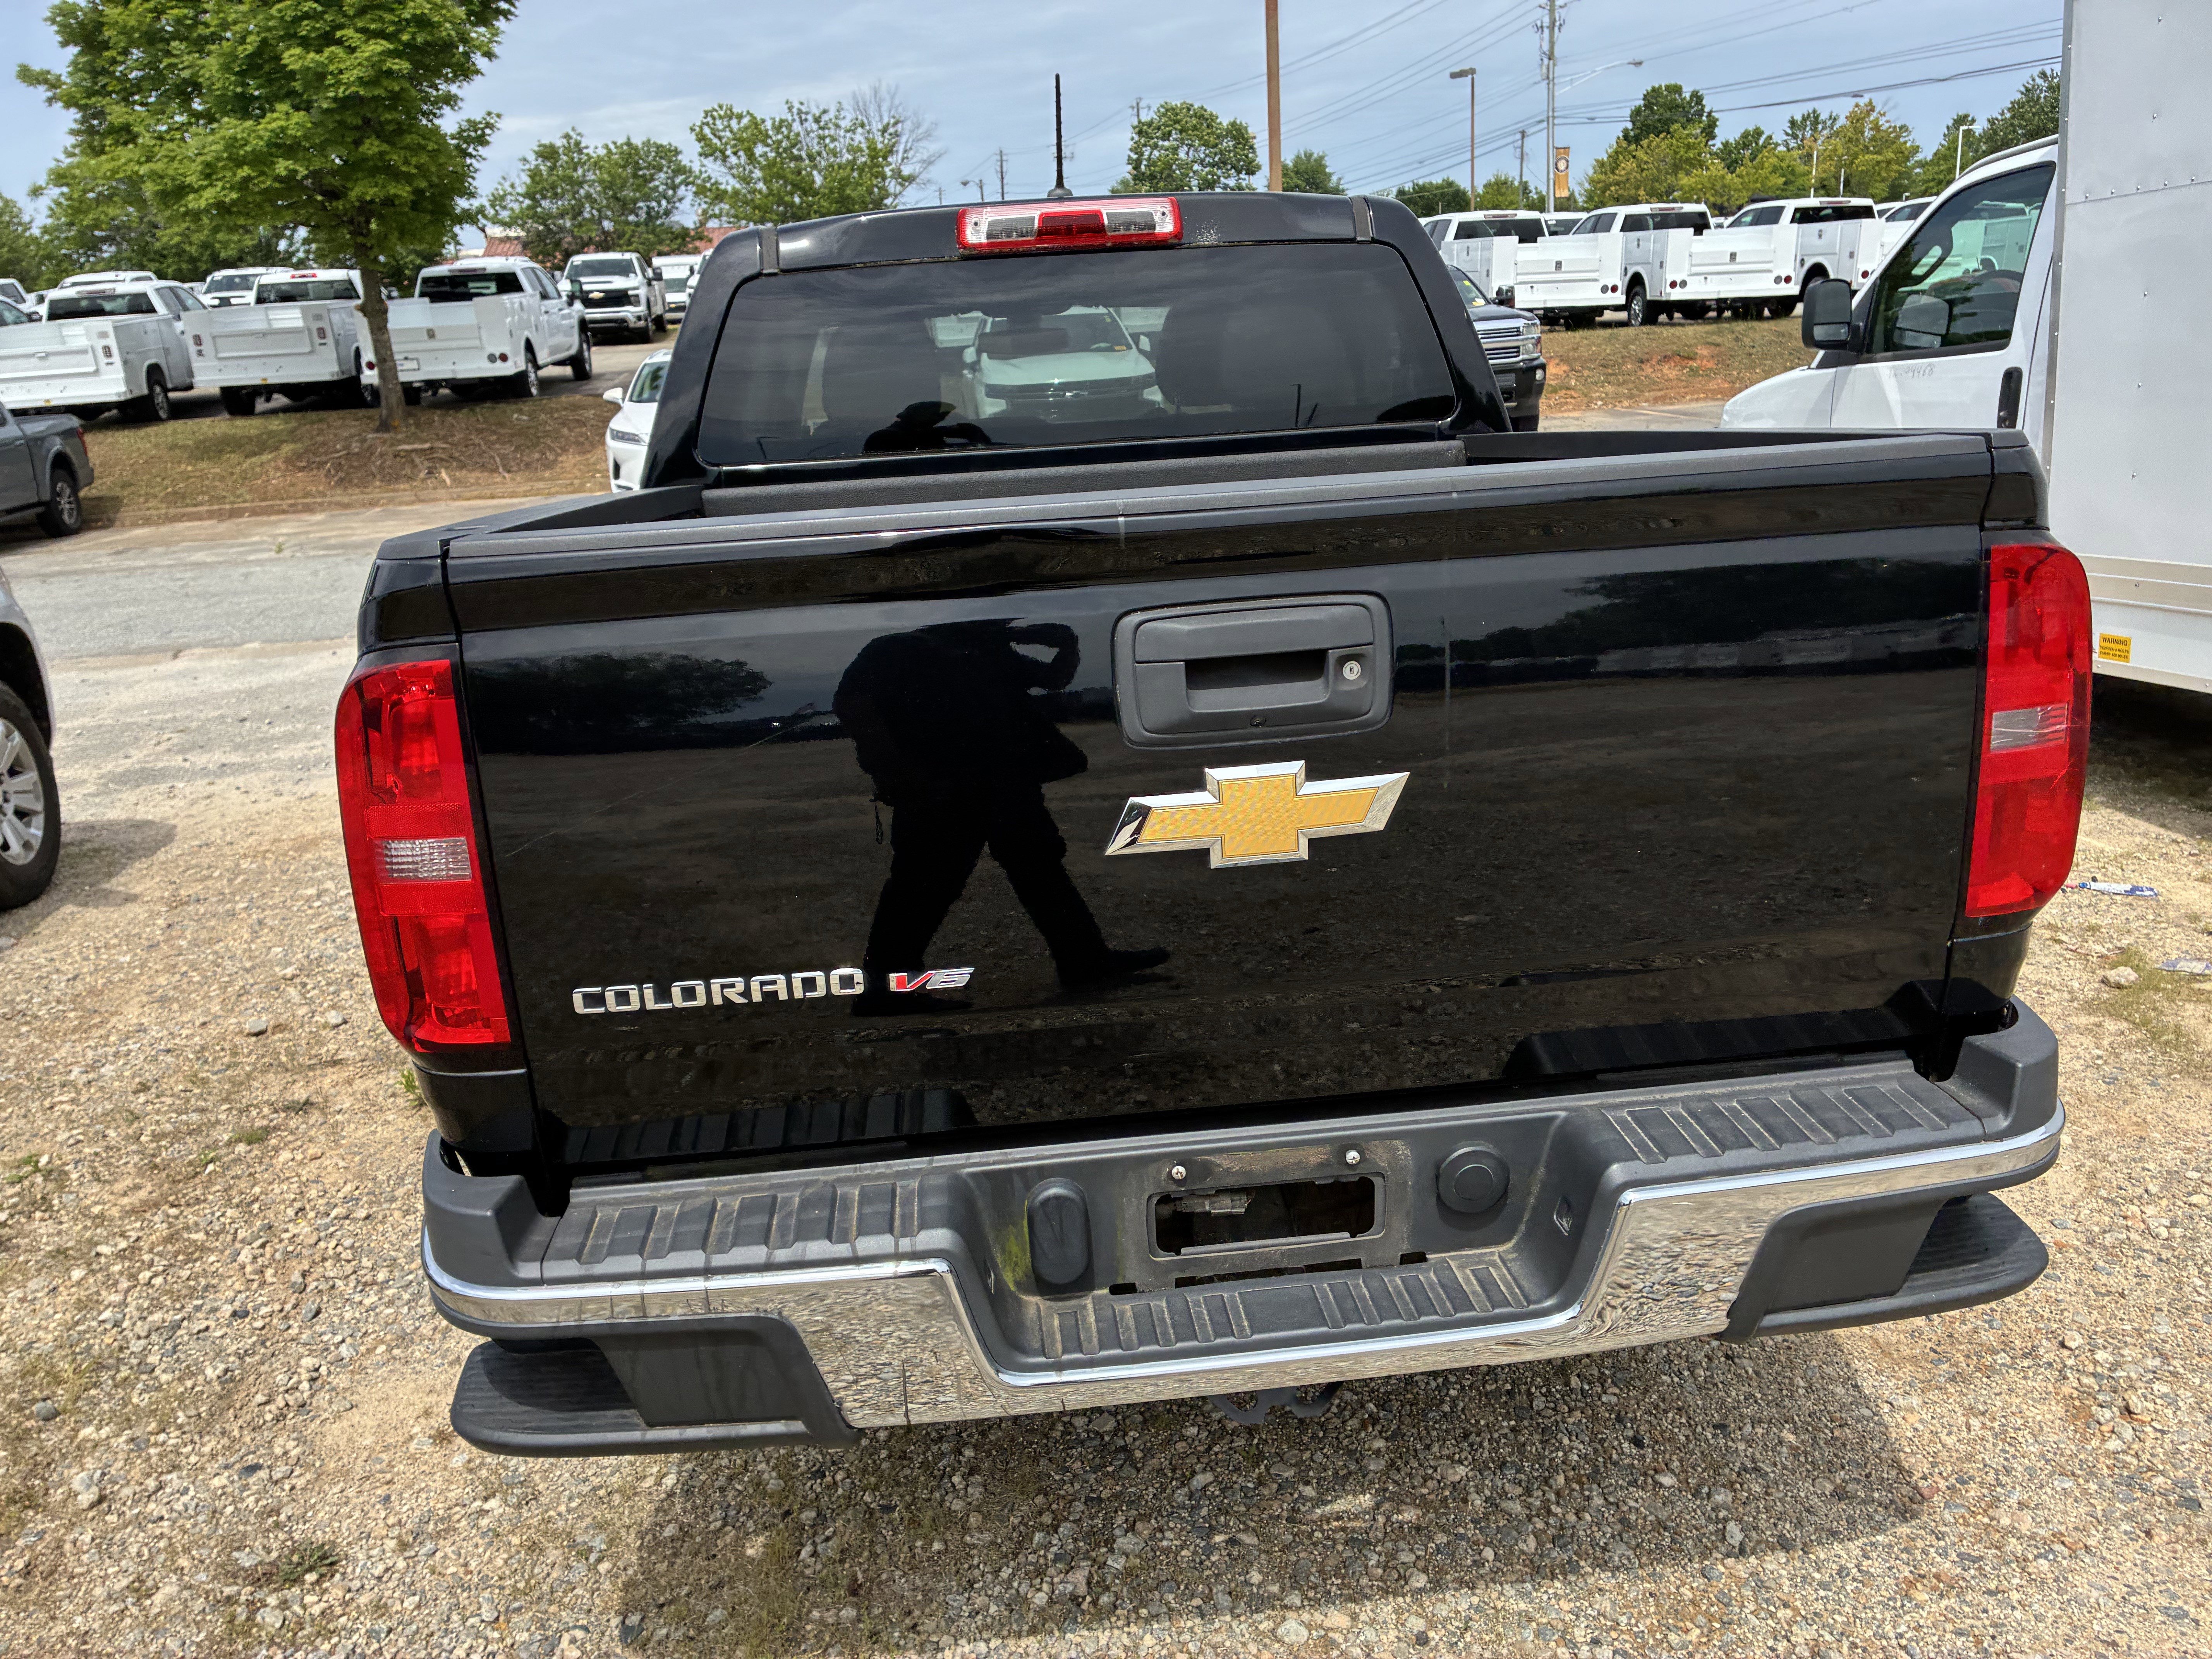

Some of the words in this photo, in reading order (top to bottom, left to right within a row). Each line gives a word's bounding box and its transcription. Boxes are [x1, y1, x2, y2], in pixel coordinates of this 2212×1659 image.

[2102, 636, 2128, 646] WARNING
[572, 967, 865, 1015] COLORADO
[889, 967, 975, 992] V6
